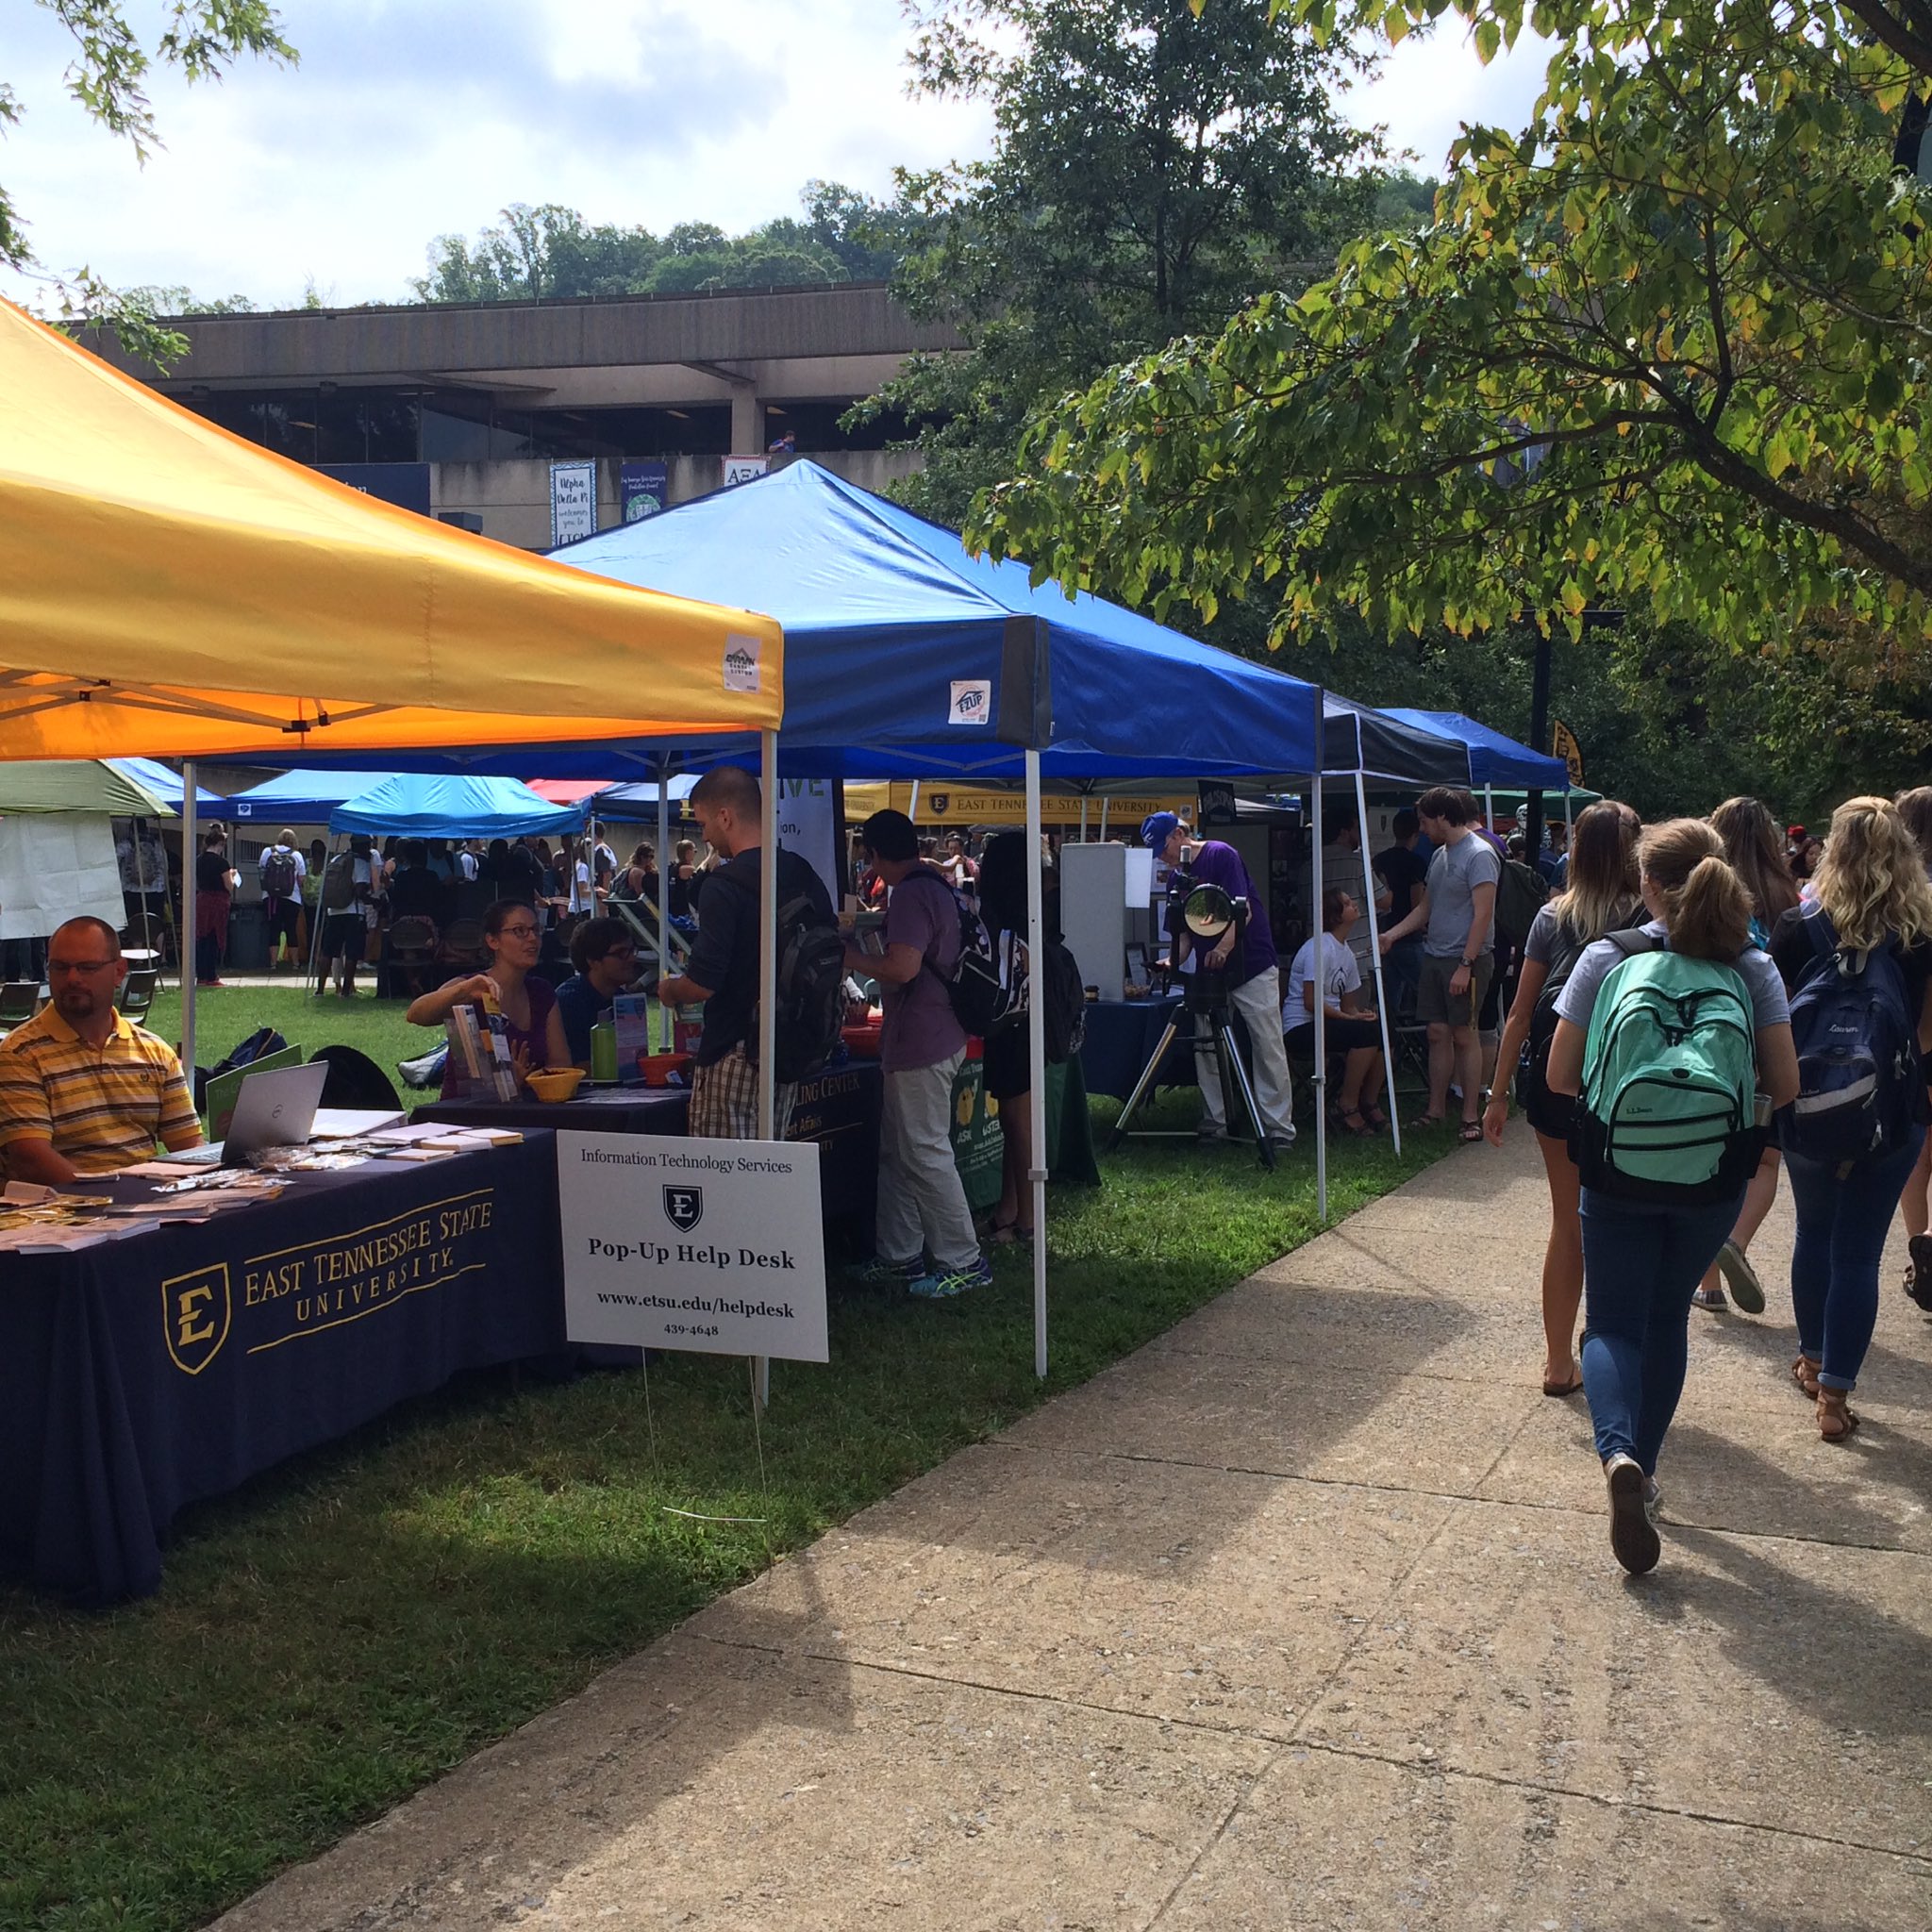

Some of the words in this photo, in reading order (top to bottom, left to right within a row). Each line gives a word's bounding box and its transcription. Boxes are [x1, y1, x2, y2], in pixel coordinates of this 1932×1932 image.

[958, 799, 986, 810] EAST
[991, 799, 1054, 810] TENNEEE
[821, 1072, 860, 1098] CENTER
[581, 1148, 658, 1166] Information
[659, 1153, 735, 1174] Technology
[738, 1158, 792, 1174] Services
[245, 1261, 305, 1307] EAST
[313, 1220, 431, 1285] TENNESSEE
[440, 1202, 493, 1241] STATE
[589, 1238, 670, 1265] Pop-Up
[677, 1244, 731, 1269] Help
[739, 1248, 796, 1270] Desk
[296, 1246, 453, 1322] UNIVERSITY
[597, 1292, 794, 1319] www.etsu.edu/helpdesk
[664, 1323, 719, 1337] 439-4648
